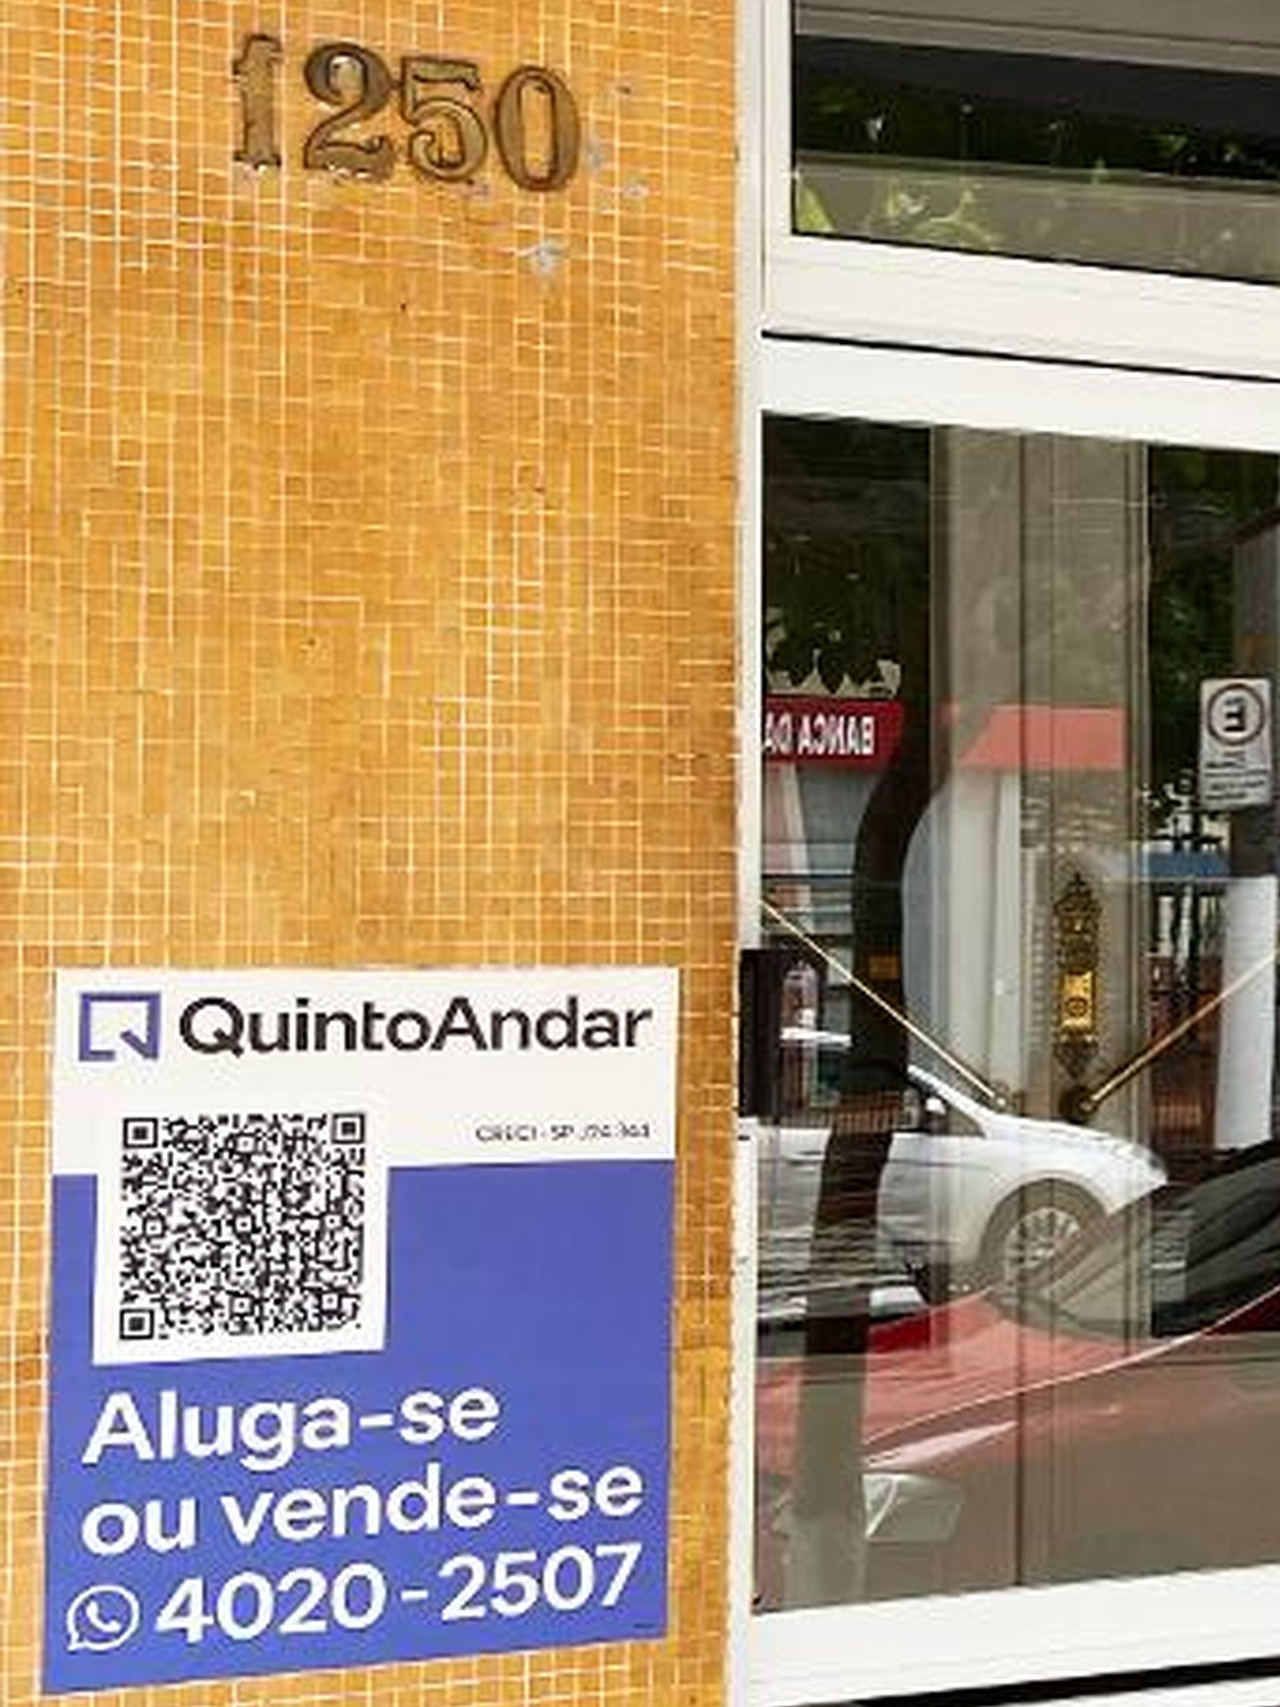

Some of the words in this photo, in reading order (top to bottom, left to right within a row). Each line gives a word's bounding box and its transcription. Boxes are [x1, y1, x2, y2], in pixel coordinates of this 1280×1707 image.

[232, 34, 581, 193] 1250
[178, 995, 653, 1057] QuintoAndar
[81, 1385, 500, 1471] Aluga-se
[81, 1496, 196, 1556] ou
[221, 1462, 644, 1546] vende-se
[154, 1542, 642, 1644] 4020-2507
